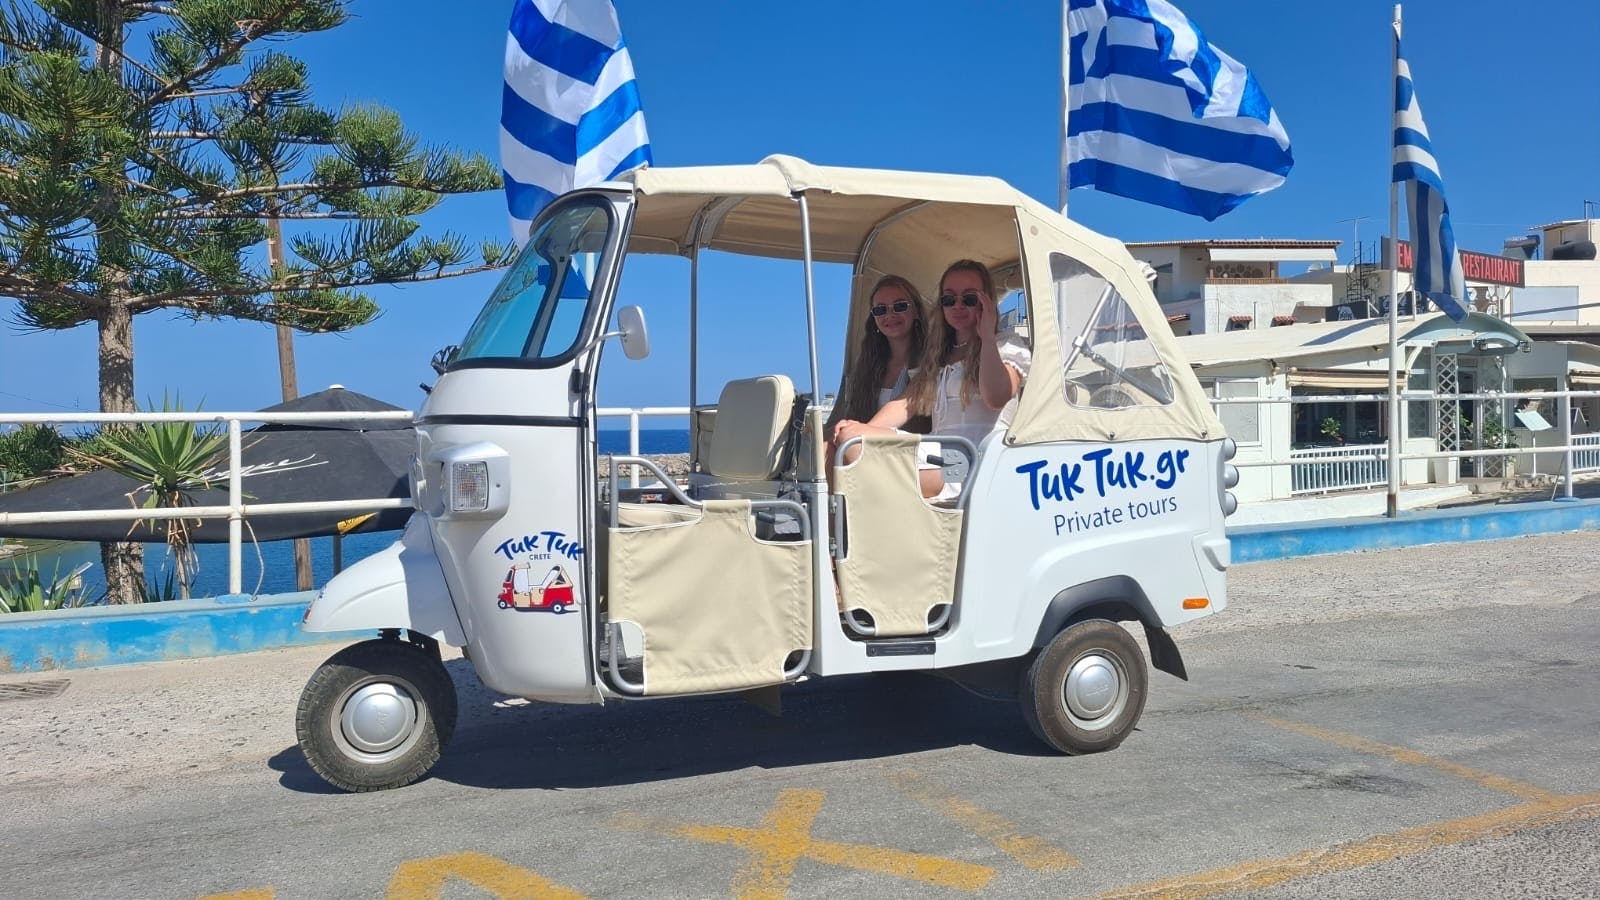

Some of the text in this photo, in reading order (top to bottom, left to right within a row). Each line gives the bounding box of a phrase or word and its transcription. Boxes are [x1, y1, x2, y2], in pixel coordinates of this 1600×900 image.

[1463, 253, 1521, 284] RESTAURANT
[1054, 496, 1177, 536] Private tours
